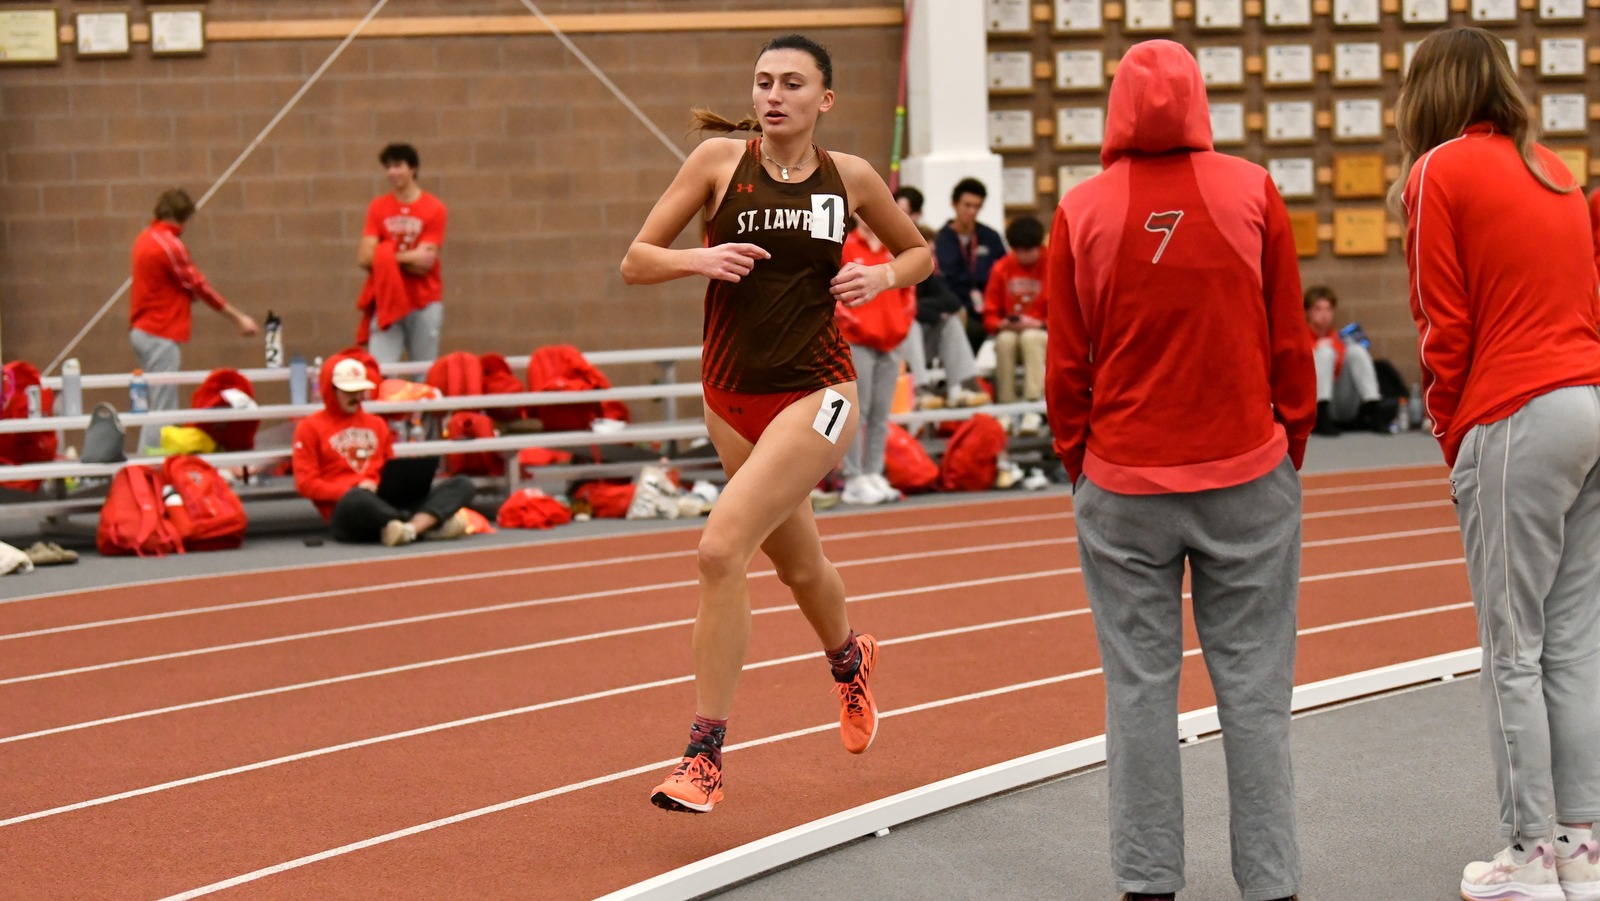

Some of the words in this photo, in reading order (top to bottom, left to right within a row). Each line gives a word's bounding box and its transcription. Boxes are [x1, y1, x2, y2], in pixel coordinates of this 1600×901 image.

[737, 209, 760, 235] ST.
[763, 208, 845, 235] LAWR
[821, 197, 835, 238] 1
[824, 398, 845, 437] 1
